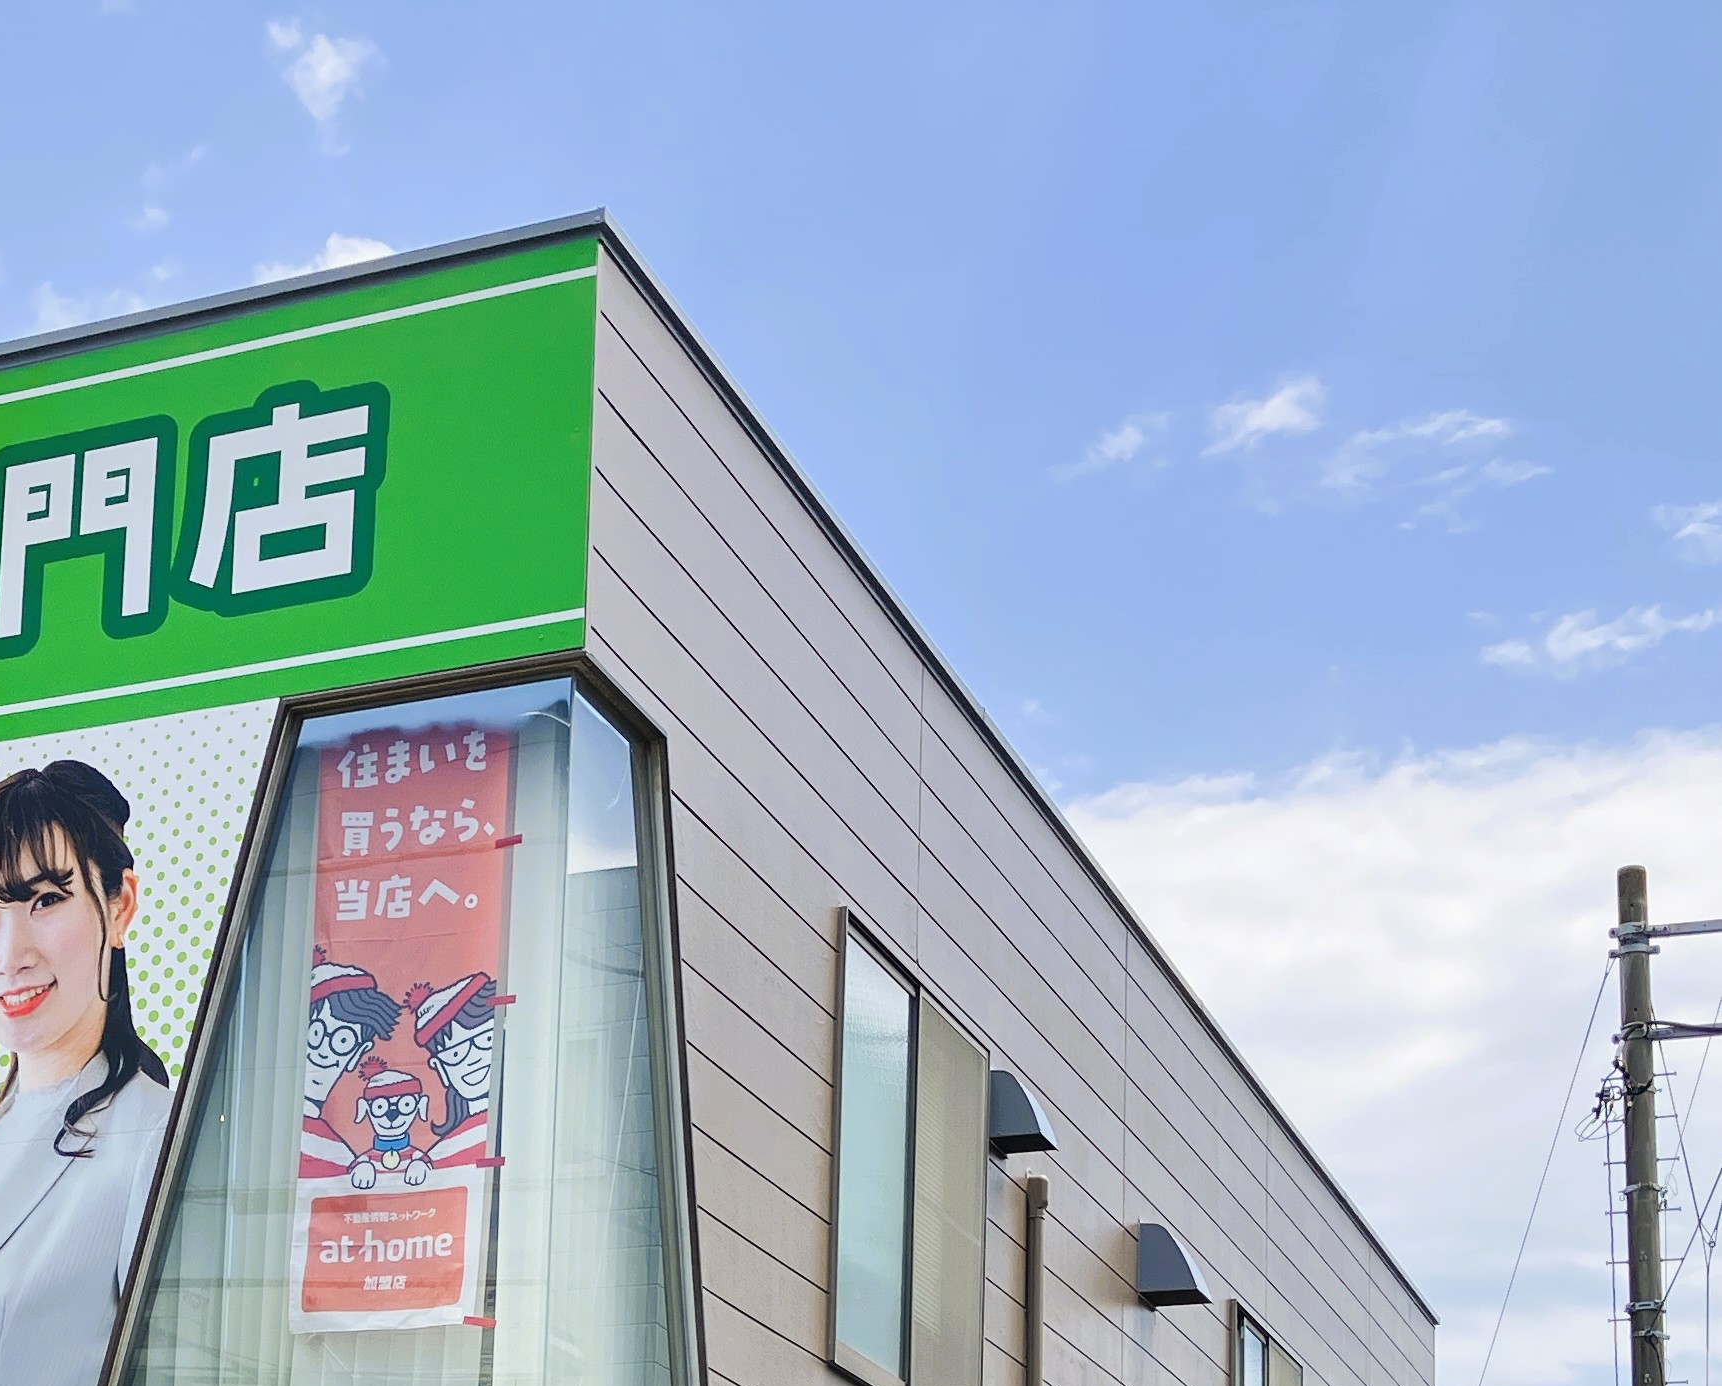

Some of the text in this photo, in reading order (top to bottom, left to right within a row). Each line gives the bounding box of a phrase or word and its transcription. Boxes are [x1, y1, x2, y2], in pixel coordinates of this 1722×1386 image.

[336, 730, 487, 789] 住まいを
[341, 799, 495, 856] 買うなら、
[334, 875, 479, 921] 当店へ。
[344, 1208, 437, 1224] 不動産情報ネットワーク
[319, 1229, 453, 1263] at home
[363, 1275, 407, 1290] 加盟店
